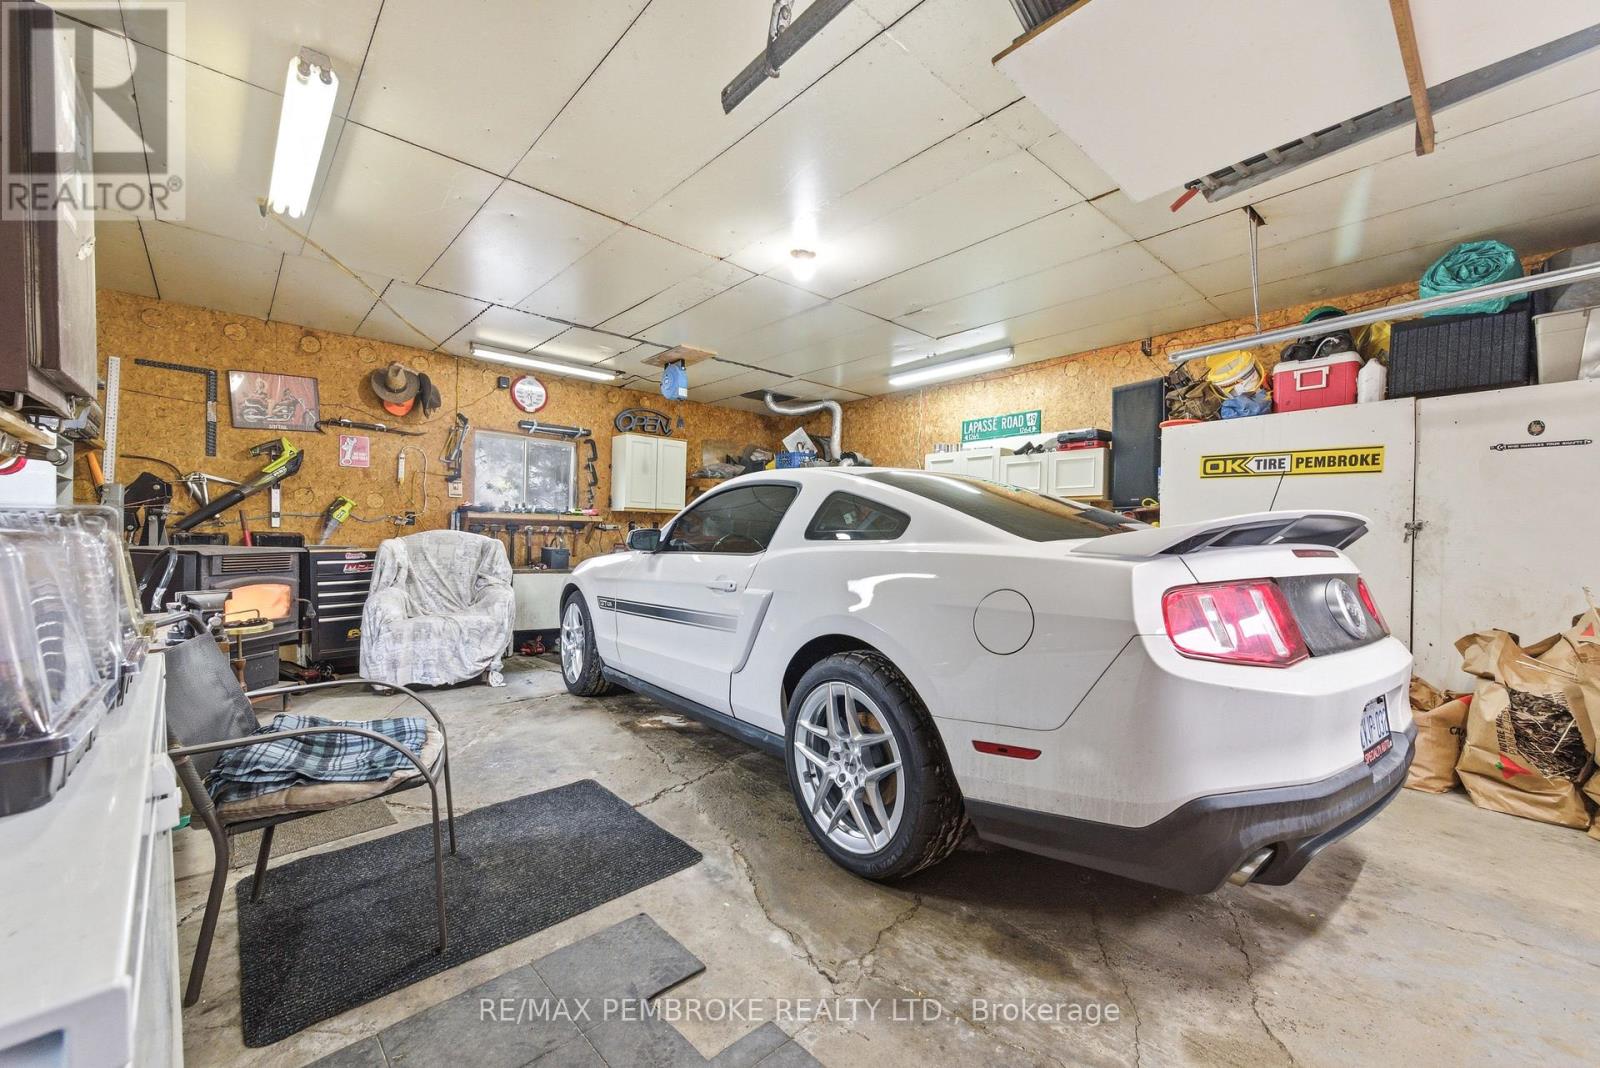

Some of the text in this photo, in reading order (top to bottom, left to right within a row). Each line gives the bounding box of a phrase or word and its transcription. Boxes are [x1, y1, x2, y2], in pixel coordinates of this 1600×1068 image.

[620, 414, 672, 435] OPEN
[964, 417, 998, 434] LAPASSE
[1001, 414, 1024, 430] ROAD
[1205, 453, 1381, 474] OK TIRE PEMBROKE
